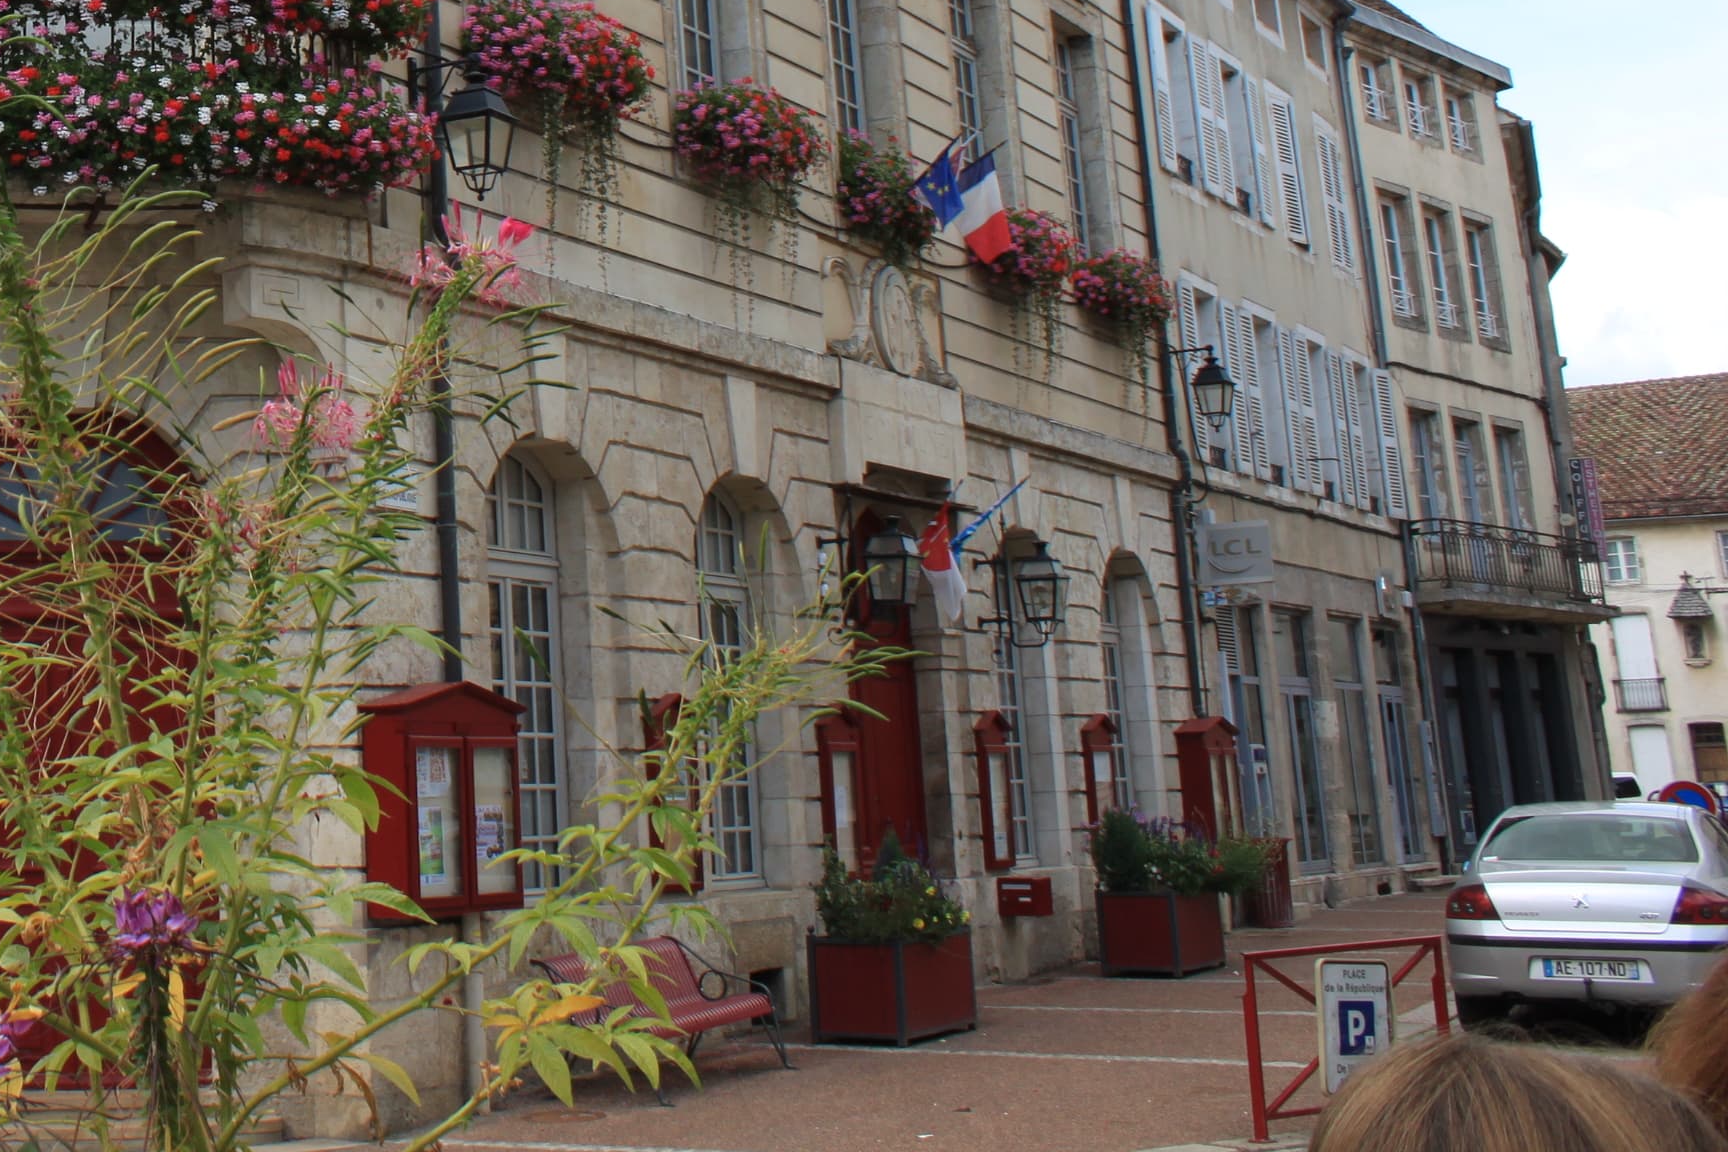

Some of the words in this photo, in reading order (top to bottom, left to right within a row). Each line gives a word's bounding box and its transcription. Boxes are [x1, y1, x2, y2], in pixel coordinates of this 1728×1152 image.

[1211, 538, 1262, 557] LCL
[1342, 969, 1366, 980] PLACE
[1555, 960, 1626, 977] AE-107-ND
[1324, 984, 1334, 993] de
[1347, 1009, 1366, 1047] P
